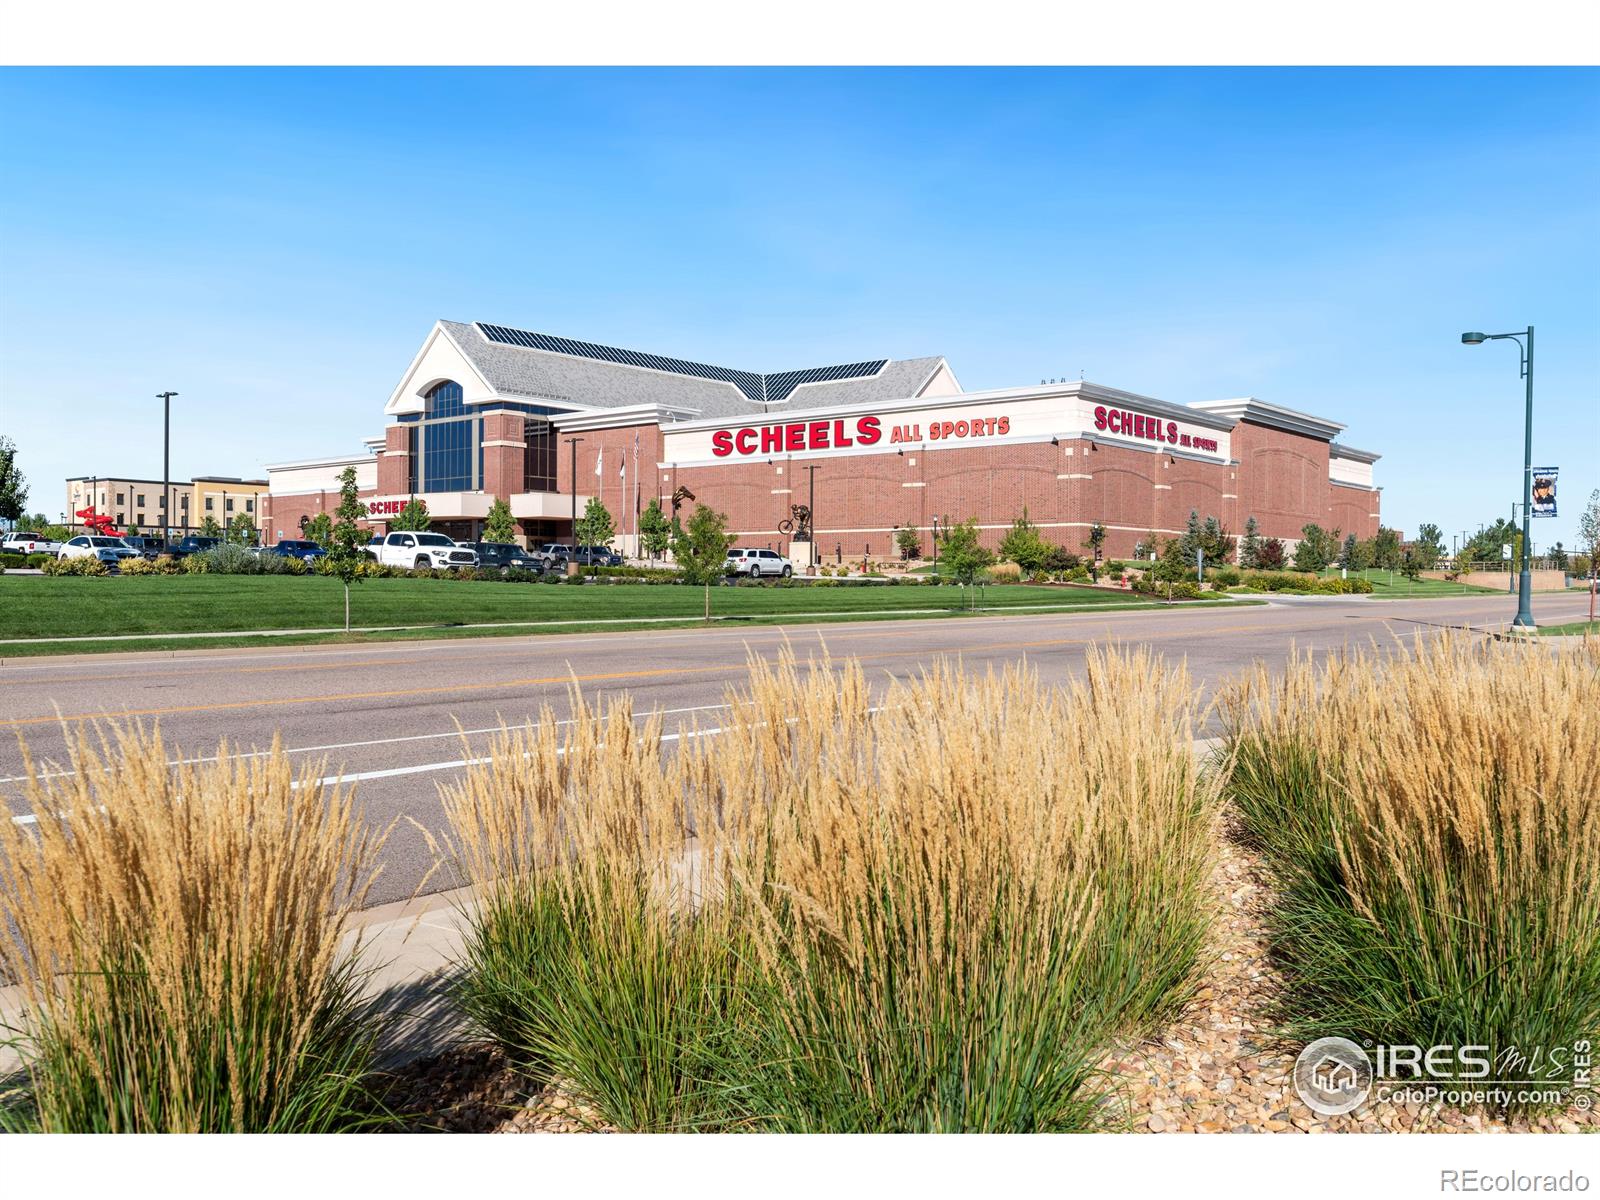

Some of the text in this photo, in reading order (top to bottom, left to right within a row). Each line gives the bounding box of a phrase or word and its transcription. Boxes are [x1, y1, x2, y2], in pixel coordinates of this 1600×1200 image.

[712, 416, 1010, 457] SCHEELS ALL SPORTS
[1094, 405, 1178, 444] SCHEELS
[369, 499, 427, 515] SCHEES
